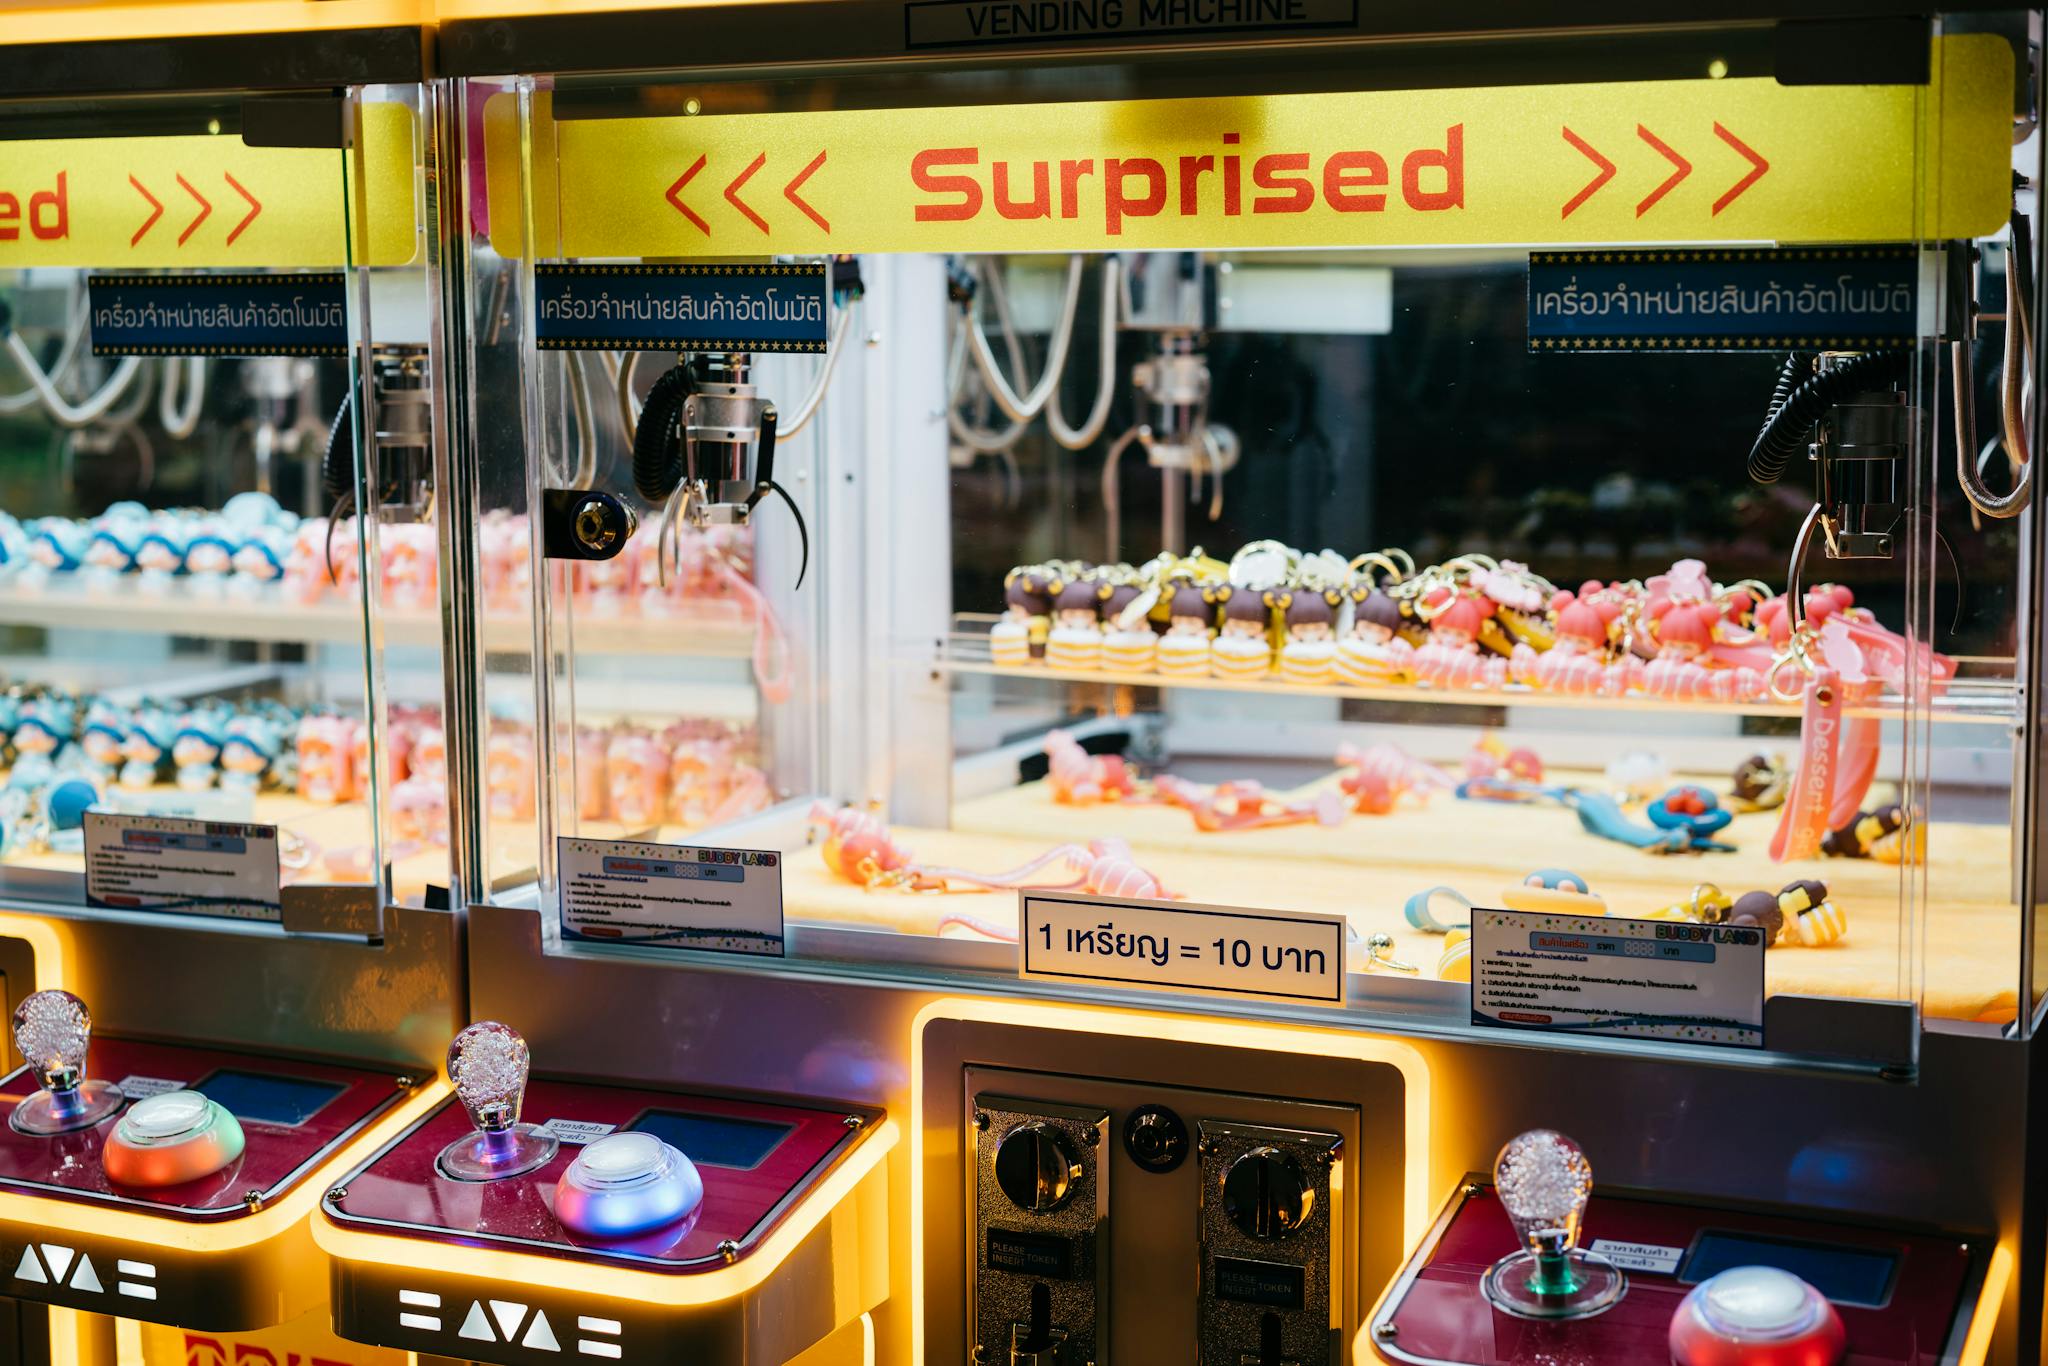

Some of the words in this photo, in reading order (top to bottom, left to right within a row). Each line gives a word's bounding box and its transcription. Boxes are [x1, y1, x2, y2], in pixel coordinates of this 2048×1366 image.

[966, 1, 1123, 36] VENDING
[1139, 0, 1307, 26] MACHINE
[910, 122, 1465, 235] Surprised
[540, 285, 822, 321] เครื่องจำหน่ายสินค้าอัตโนมัติ
[1535, 275, 1911, 315] เครื่องจำหน่ายสินค้าอัตโนมัติ
[95, 296, 343, 328] เครื่องจำหน่ายสินค้าอัตโนมัติ
[1807, 718, 1835, 814] Dessert
[698, 850, 741, 865] BUDDY
[742, 852, 776, 867] LAND
[1039, 923, 1052, 950] 1
[1066, 922, 1169, 967] เหรียญ
[1212, 938, 1252, 968] 10
[1262, 945, 1326, 975] บาท
[1655, 924, 1712, 942] BUDDY
[1713, 929, 1760, 945] LAND
[992, 1242, 1025, 1255] PLEASE
[992, 1253, 1025, 1265] INSERT
[1026, 1253, 1058, 1265] TOKEN
[1257, 1282, 1292, 1293] TOKEN
